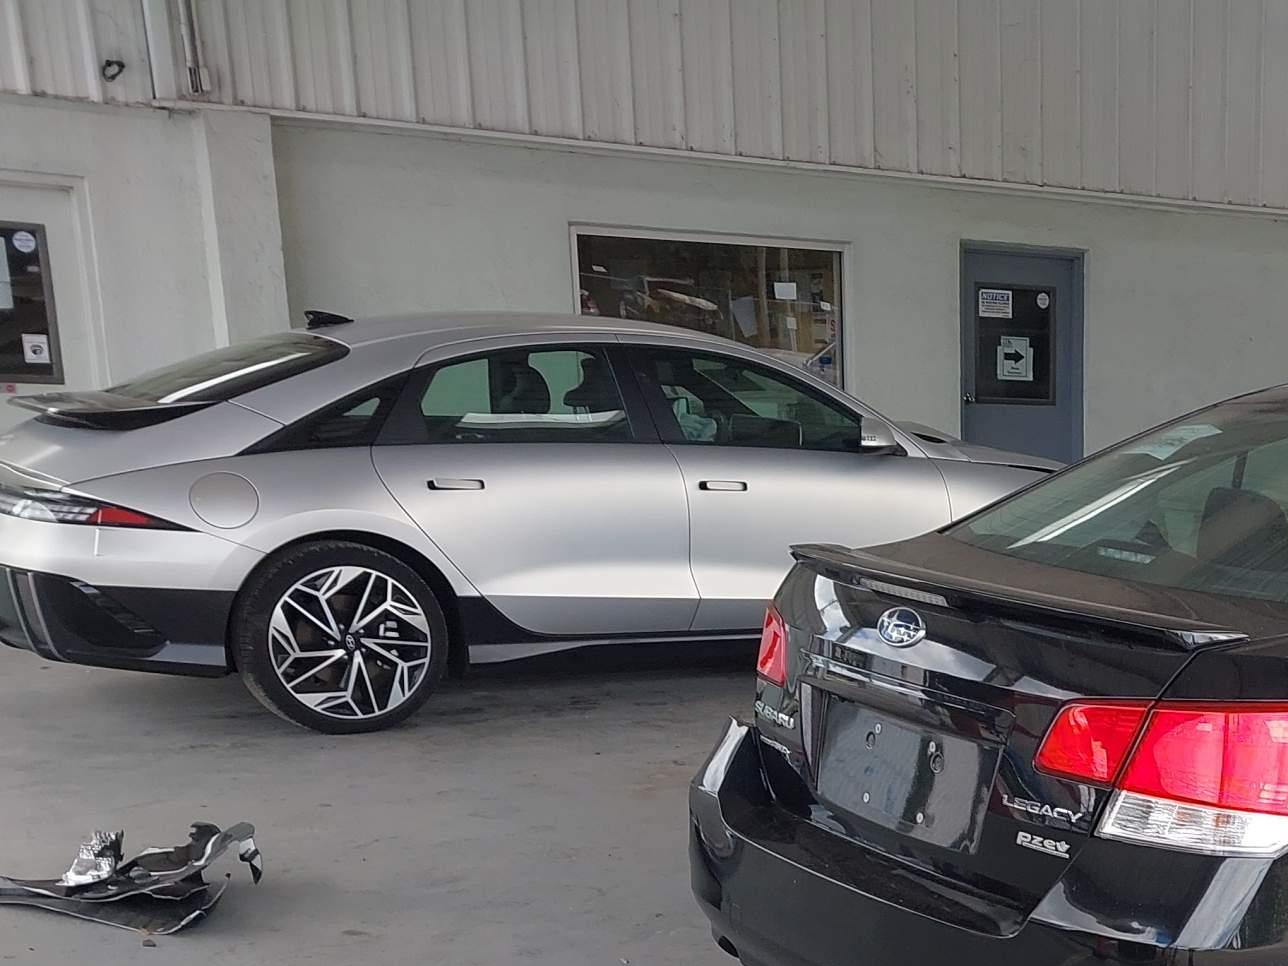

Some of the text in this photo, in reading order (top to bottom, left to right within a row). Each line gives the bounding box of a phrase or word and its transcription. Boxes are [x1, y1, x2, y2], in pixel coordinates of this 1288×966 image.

[982, 292, 1008, 301] NOTICE
[755, 700, 794, 729] SUBARU
[1002, 794, 1083, 823] LEGACY
